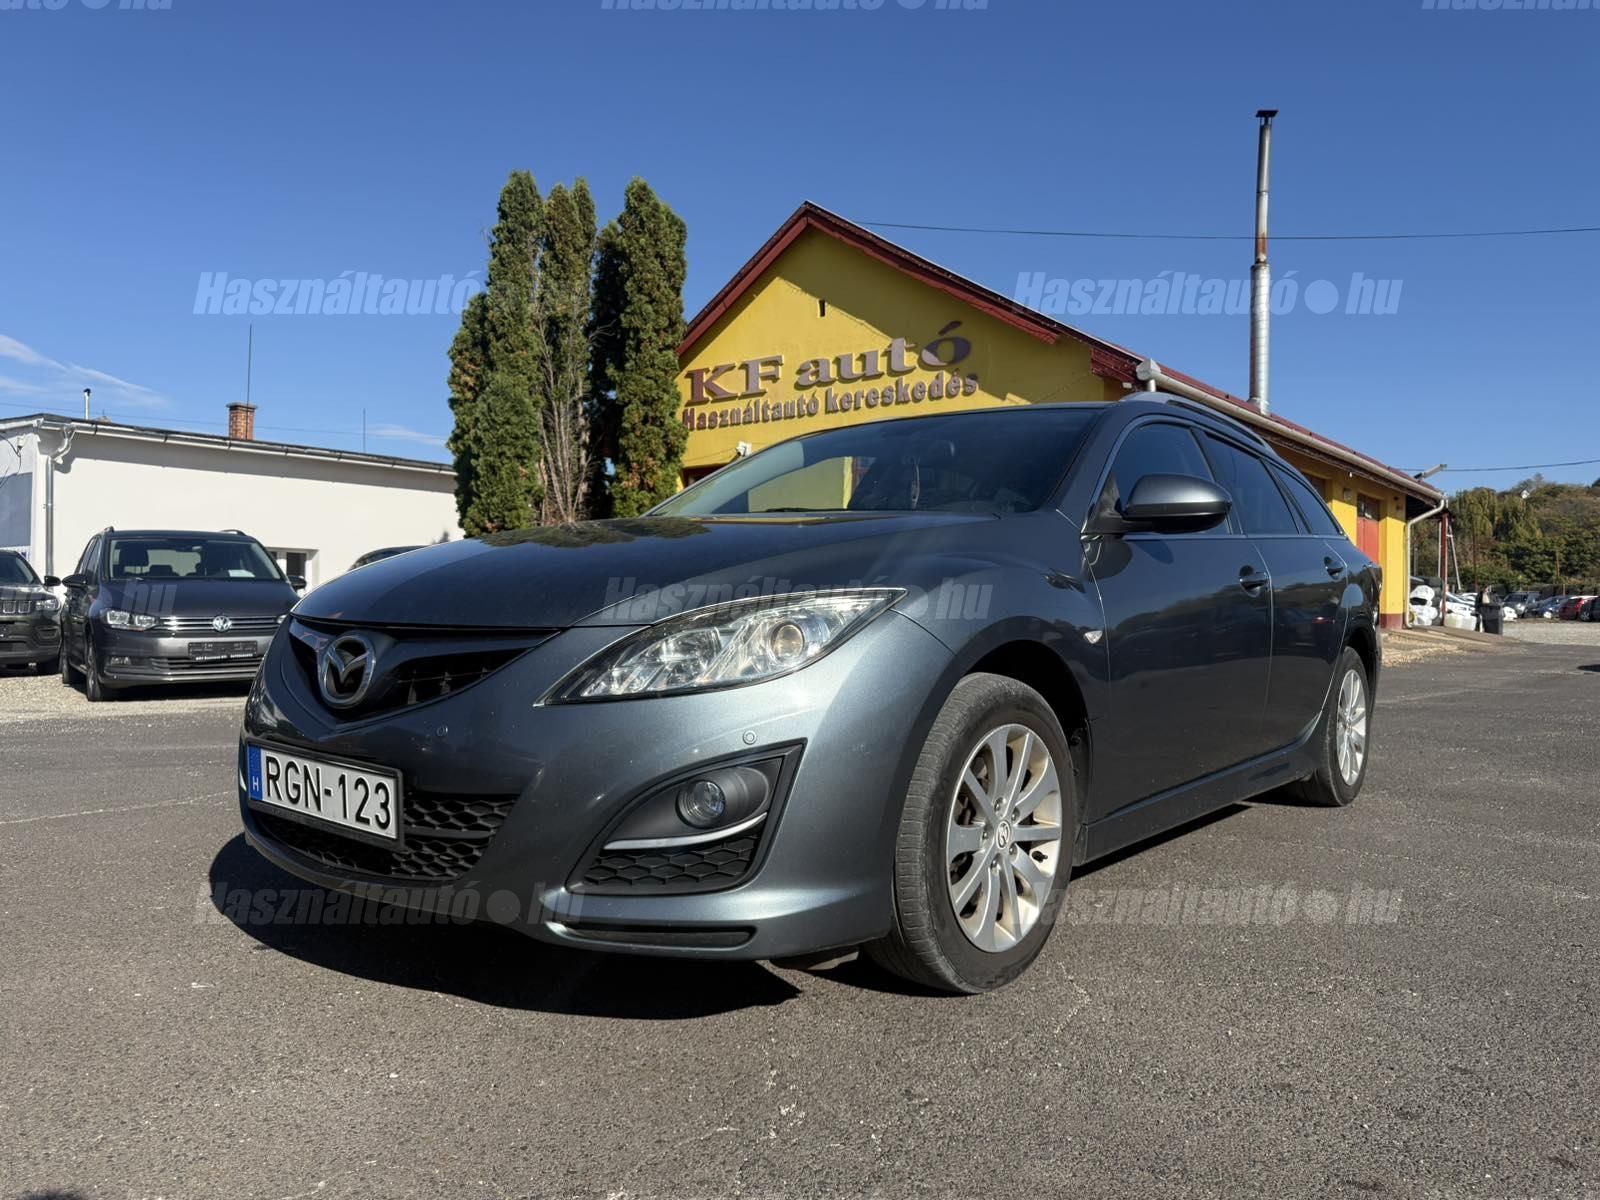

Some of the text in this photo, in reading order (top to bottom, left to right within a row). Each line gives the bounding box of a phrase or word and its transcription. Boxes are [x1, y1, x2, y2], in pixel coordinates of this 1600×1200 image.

[682, 368, 979, 432] Használtautó kereskedés
[684, 320, 972, 406] KF autó
[265, 755, 392, 831] RGN-123
